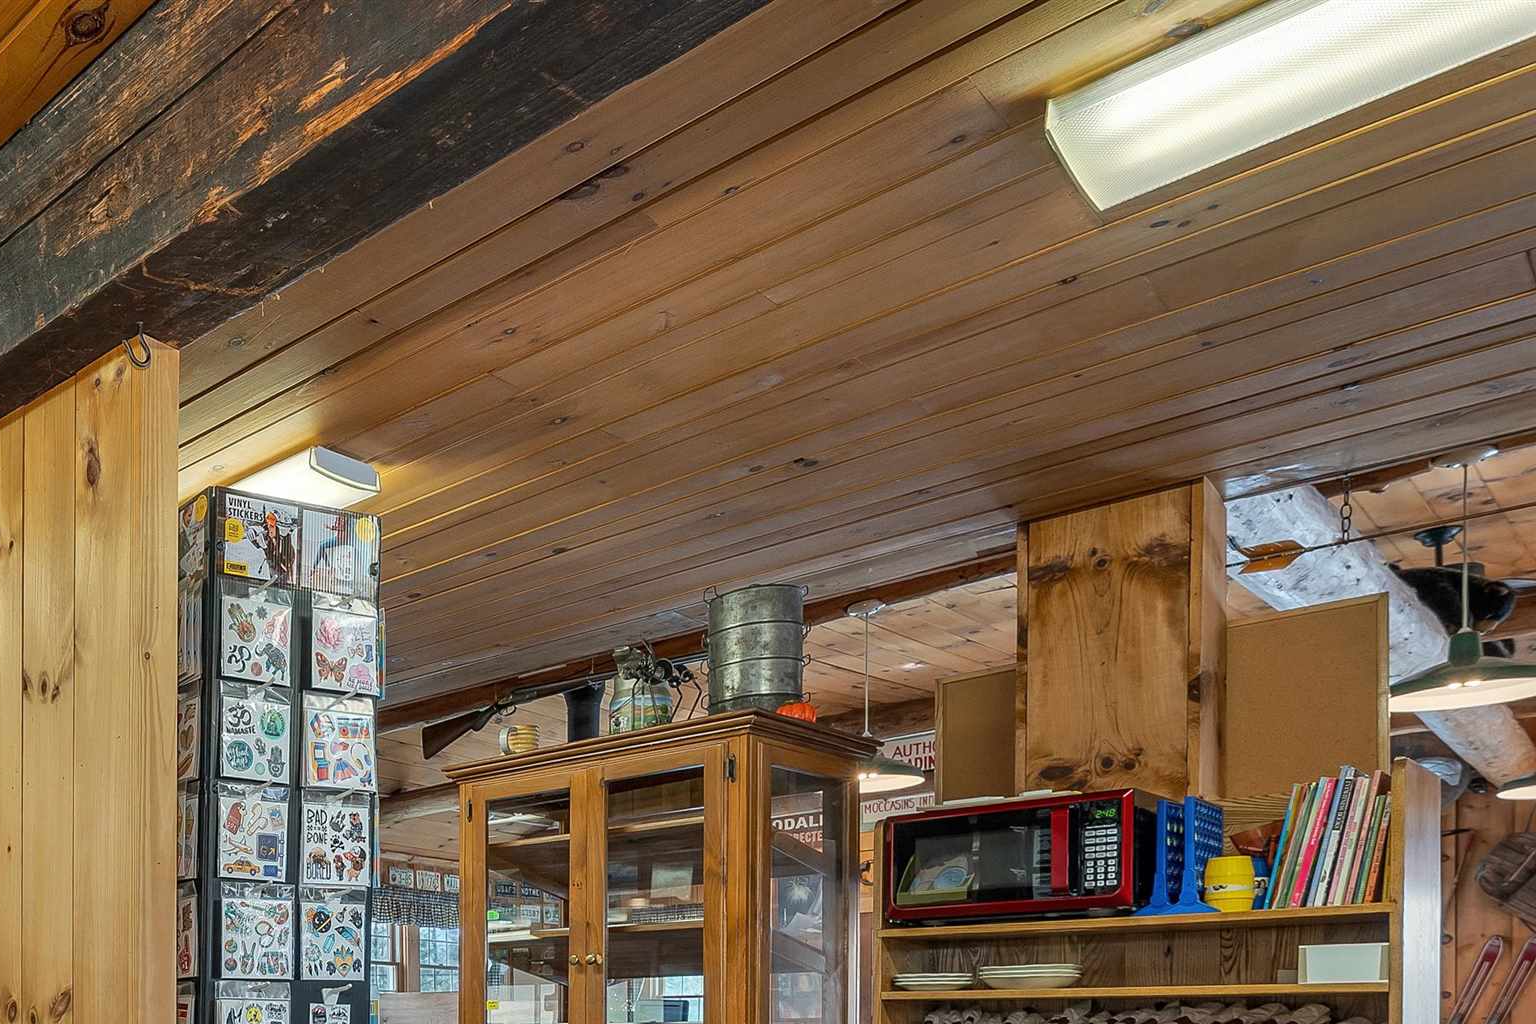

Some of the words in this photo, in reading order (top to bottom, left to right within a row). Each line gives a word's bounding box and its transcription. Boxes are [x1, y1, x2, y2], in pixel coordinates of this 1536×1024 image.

[228, 497, 252, 509] VINYL
[228, 508, 264, 521] STICKERS
[226, 725, 256, 735] NAMASTE
[865, 799, 915, 814] MOCCASINS
[306, 809, 327, 826] BAD
[306, 832, 327, 844] BONE
